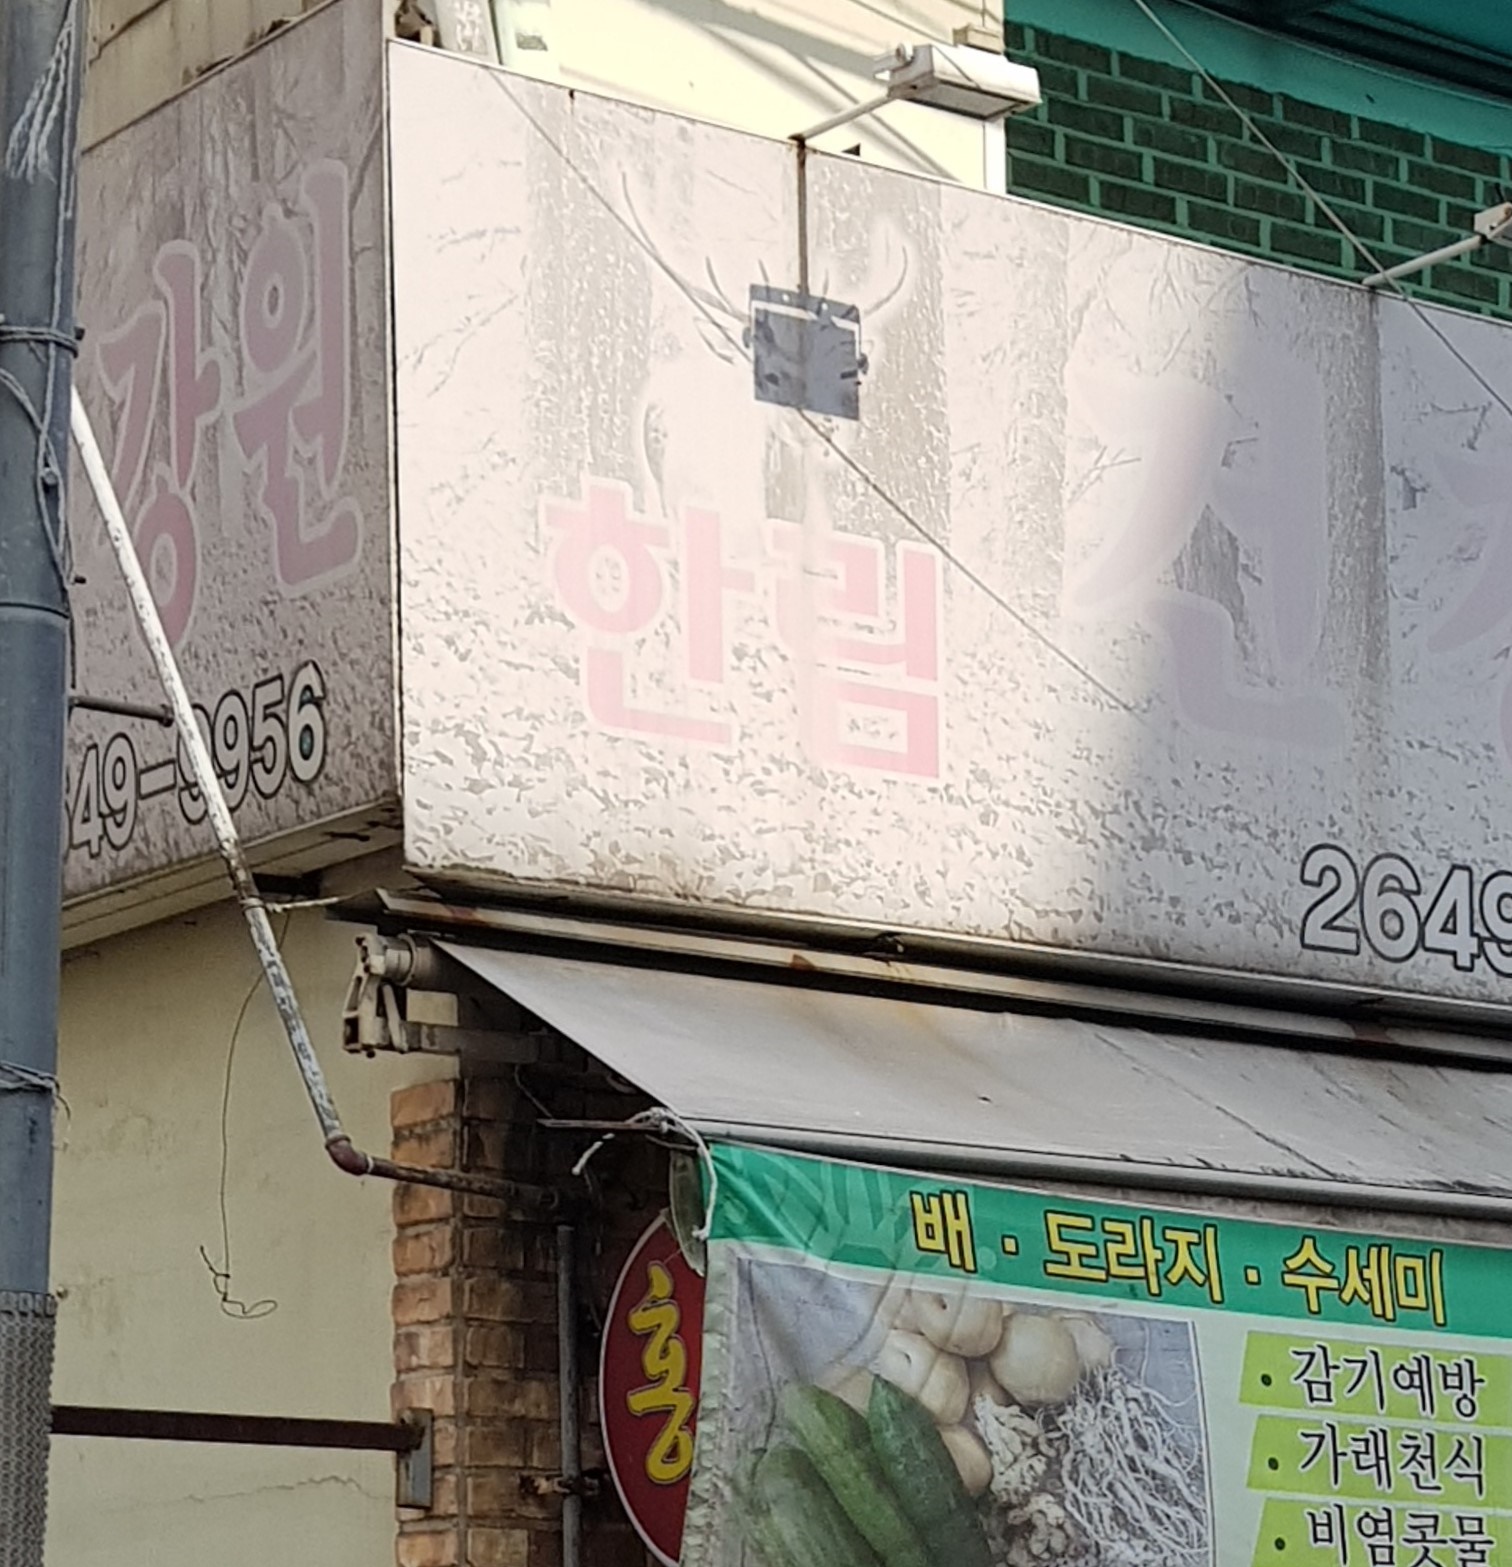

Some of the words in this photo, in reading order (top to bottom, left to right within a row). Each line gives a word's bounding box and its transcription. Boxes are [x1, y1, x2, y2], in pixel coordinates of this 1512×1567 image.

[537, 474, 943, 783] 한림
[66, 660, 326, 860] 49-9956
[910, 1190, 976, 1274] 배
[1044, 1209, 1225, 1304] 도라지
[1282, 1236, 1448, 1327] 수세미
[1290, 1343, 1486, 1421] 감기예방
[1298, 1422, 1488, 1498] 가래천식
